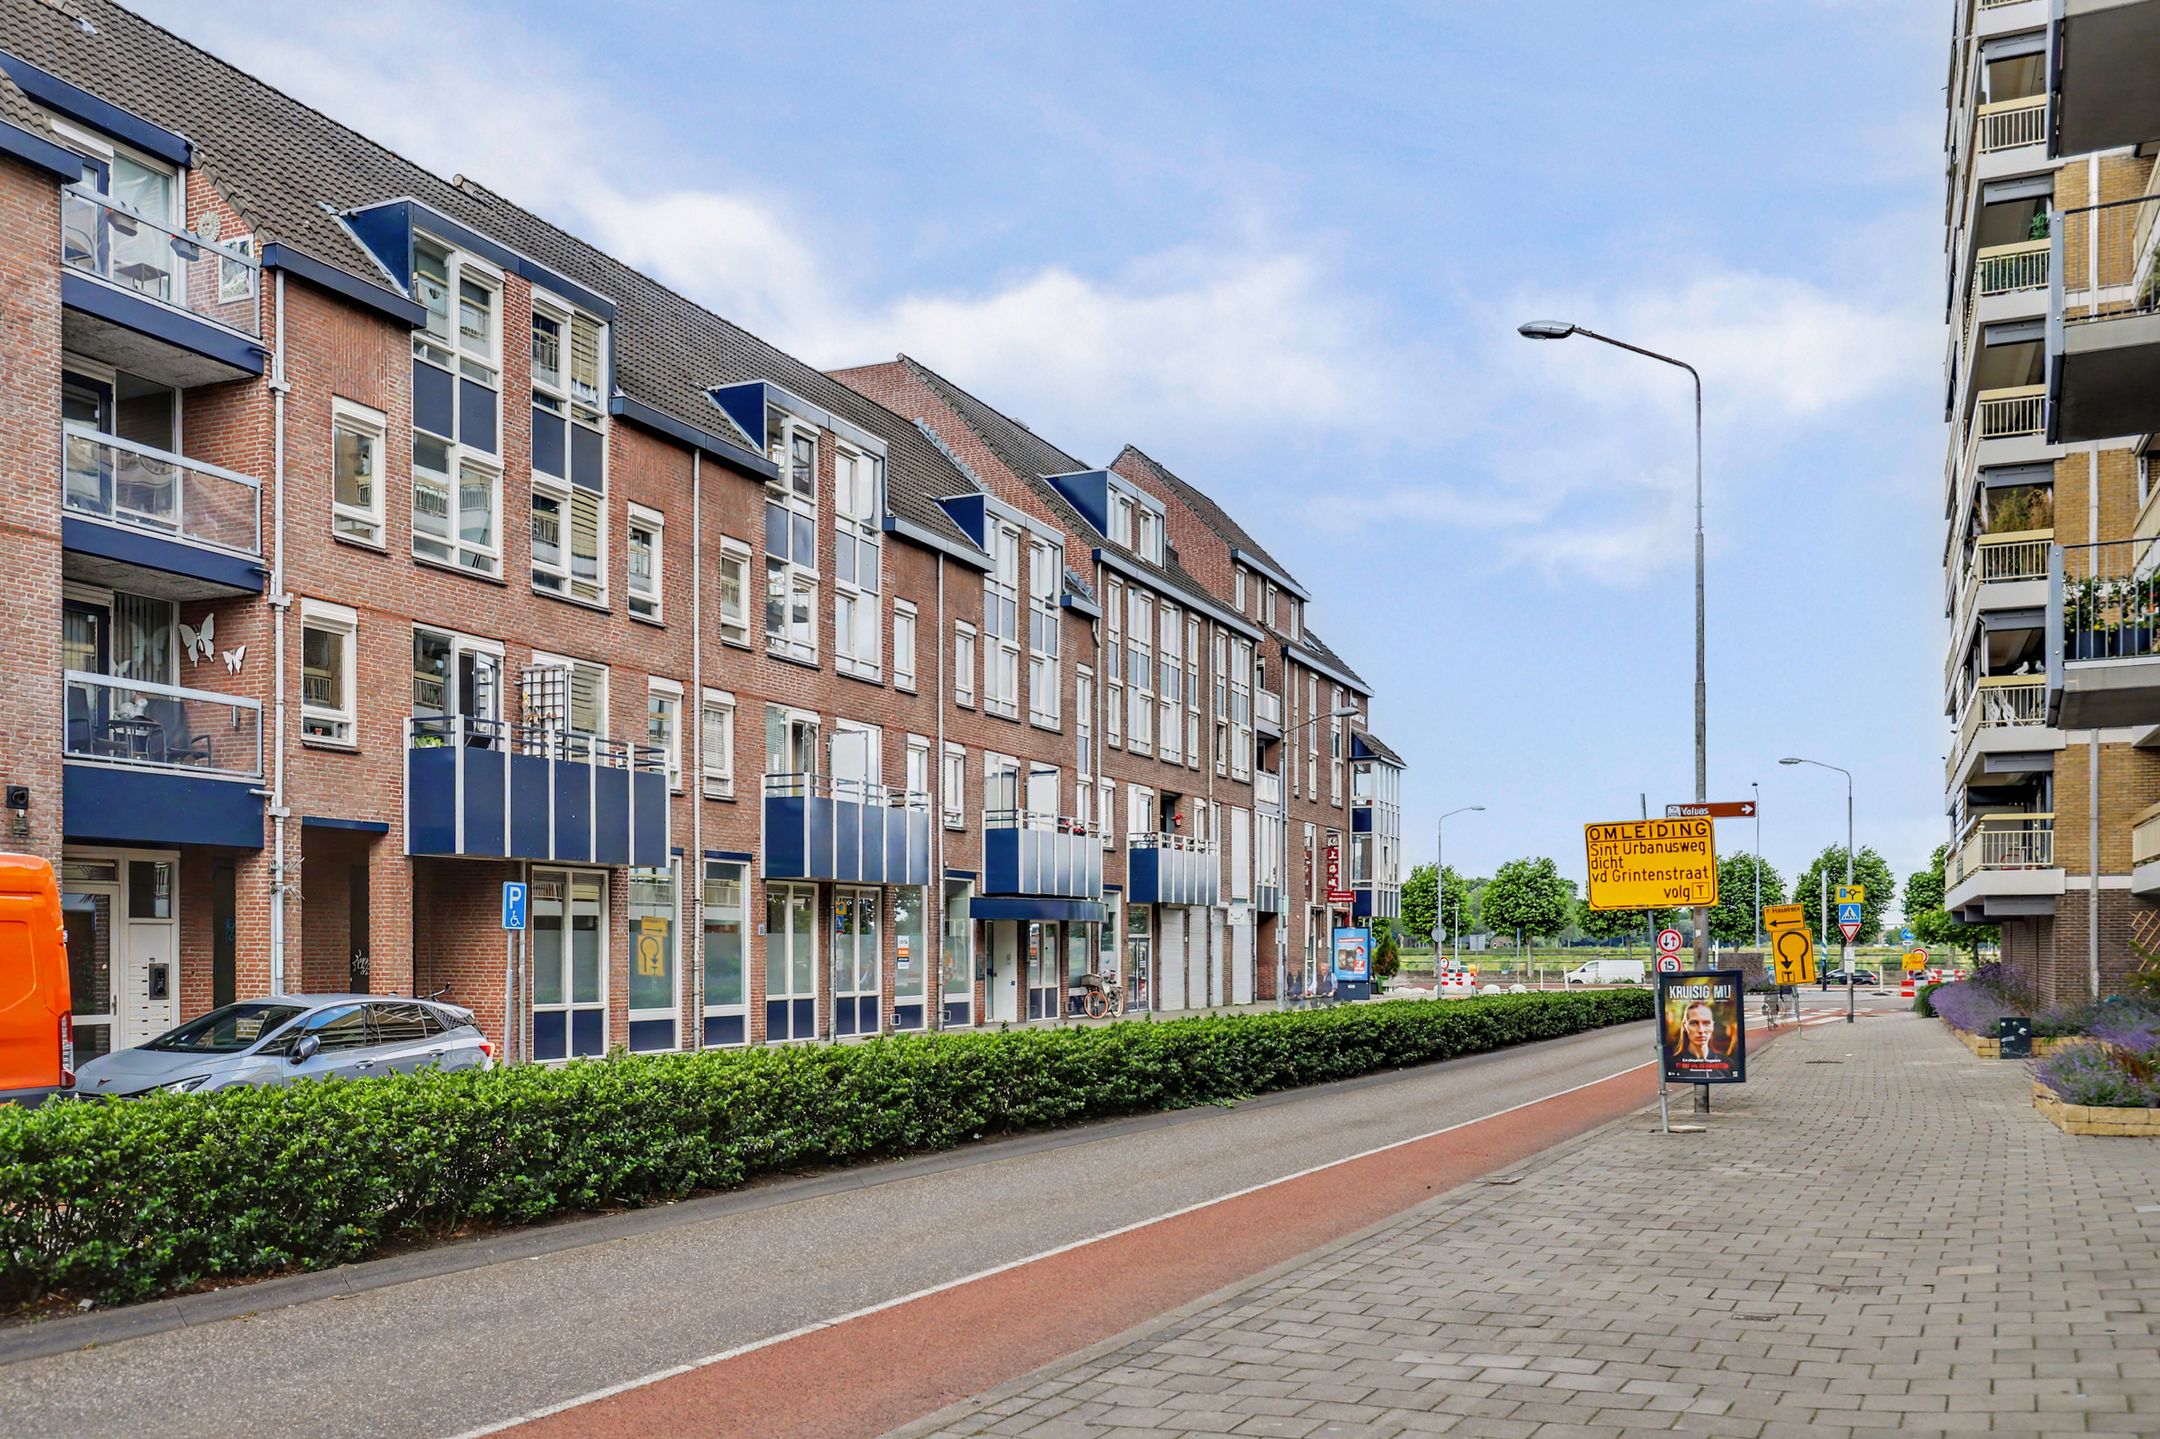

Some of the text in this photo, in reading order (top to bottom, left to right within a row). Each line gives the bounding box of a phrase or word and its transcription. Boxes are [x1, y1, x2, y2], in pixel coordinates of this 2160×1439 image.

[1590, 822, 1707, 840] OMLEIDING
[1590, 840, 1706, 857] Sint Urbanusweg
[1591, 856, 1624, 870] dicht
[1591, 865, 1709, 883] vd Grintenstraat
[509, 887, 522, 909] P
[1663, 884, 1704, 902] volg T
[1664, 961, 1675, 970] 15
[1784, 972, 1792, 982] T
[1669, 985, 1710, 999] KRUISIG
